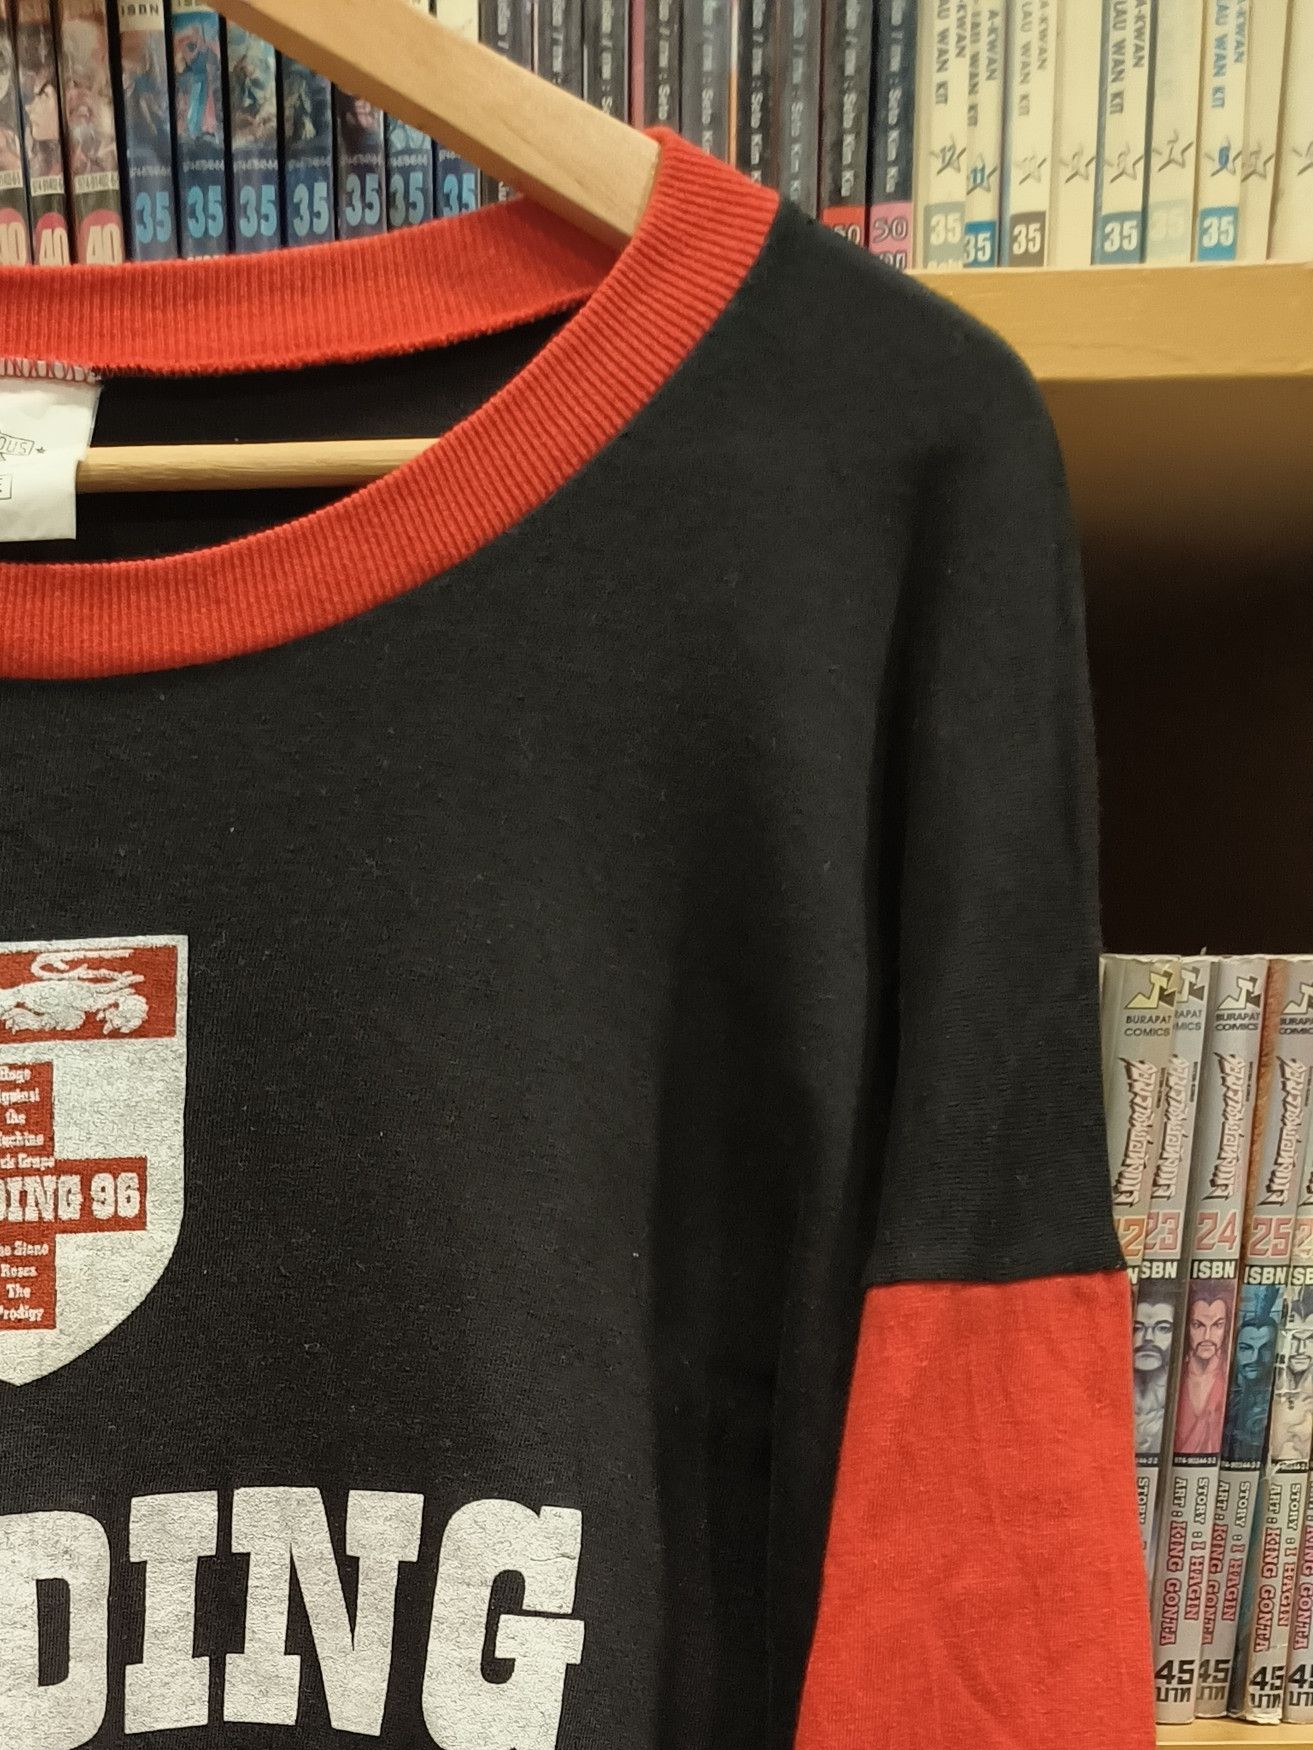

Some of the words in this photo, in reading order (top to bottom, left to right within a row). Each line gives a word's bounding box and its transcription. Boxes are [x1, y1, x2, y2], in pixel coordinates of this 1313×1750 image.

[1110, 33, 1126, 80] WAN
[1213, 33, 1228, 77] WAN
[294, 183, 328, 236] 35
[347, 173, 379, 225] 35
[390, 171, 423, 218] 35
[444, 173, 476, 213] 35
[135, 192, 171, 244] 35
[189, 187, 224, 238] 35
[241, 185, 276, 237] 35
[872, 215, 908, 240] 50
[930, 212, 962, 245] 35
[1012, 224, 1041, 253] 35
[1105, 220, 1138, 252] 35
[1202, 217, 1234, 247] 35
[964, 233, 992, 263] 35
[1124, 1028, 1170, 1036] COMICS
[1126, 1015, 1172, 1024] BURAPAT
[1216, 1023, 1259, 1031] COMICS
[5, 1109, 25, 1124] the
[91, 1172, 141, 1219] 96
[1145, 1212, 1180, 1250] 23
[1196, 1211, 1237, 1250] 24
[1250, 1218, 1292, 1257] 25
[14, 1243, 49, 1256] Stone
[1, 1264, 36, 1277] Roses
[1192, 1260, 1236, 1279] ISBN
[1245, 1266, 1286, 1284] ISBN
[7, 1284, 31, 1298] The
[1174, 1477, 1188, 1510] ART
[1194, 1477, 1209, 1527] STORY
[1215, 1481, 1230, 1511] ART
[1234, 1481, 1250, 1528] STORY
[1268, 1483, 1282, 1516] ART
[1286, 1484, 1301, 1532] STORY
[1167, 1520, 1187, 1572] KING
[1262, 1527, 1281, 1578] KING
[1184, 1556, 1205, 1621] HAGIN
[1159, 1577, 1182, 1647] GONTA
[1254, 1582, 1276, 1652] GONTA
[1154, 1660, 1195, 1684] 45
[1198, 1659, 1230, 1684] 45
[1250, 1665, 1285, 1691] 45
[1156, 1686, 1191, 1702] บาท
